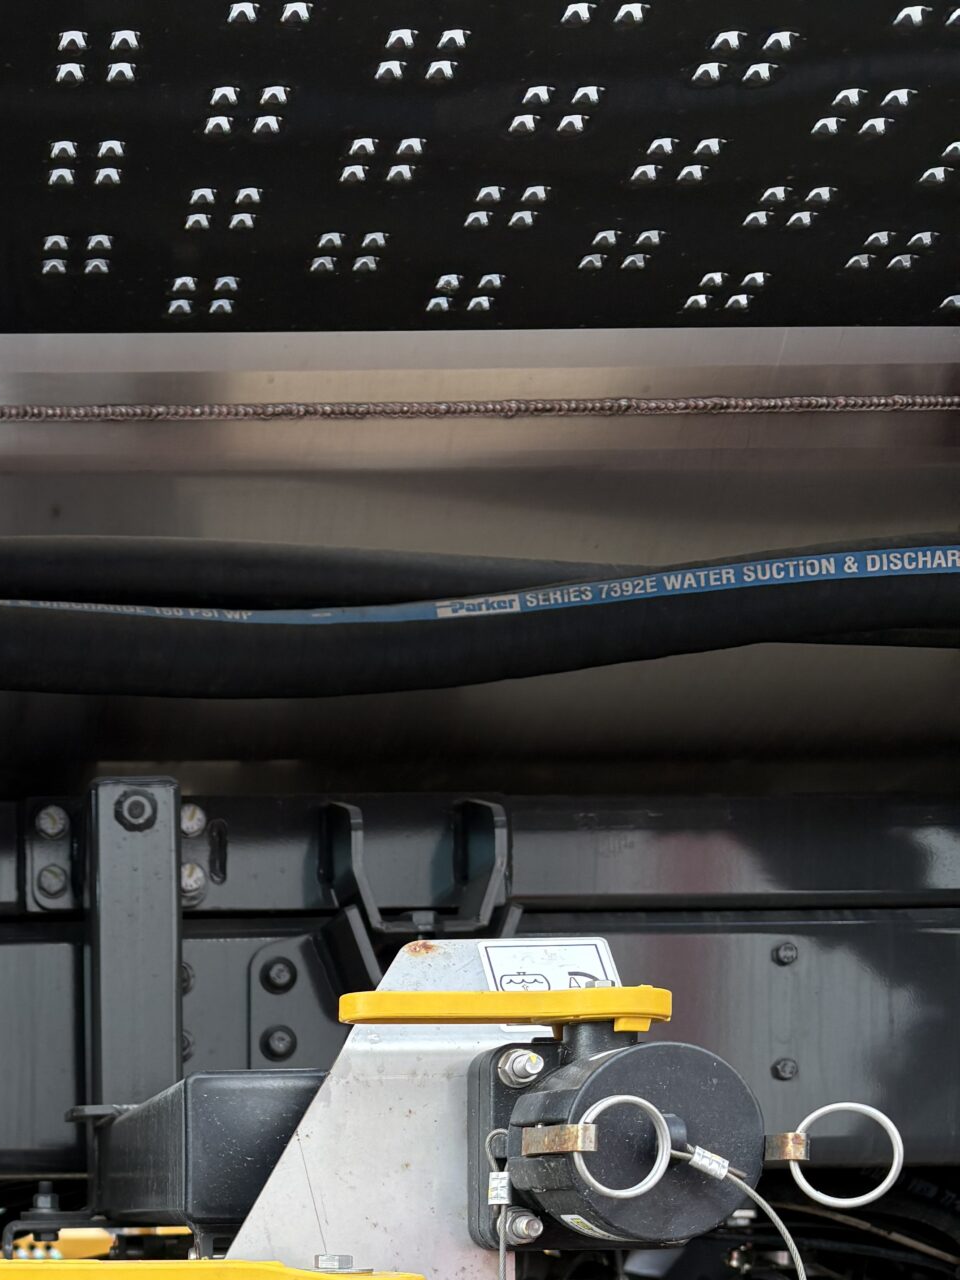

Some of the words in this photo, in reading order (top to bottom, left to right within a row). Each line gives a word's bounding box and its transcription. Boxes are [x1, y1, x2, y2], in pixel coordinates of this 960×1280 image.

[437, 595, 517, 614] Parker
[525, 586, 593, 607] SERIES
[598, 577, 658, 599] 7392E
[663, 568, 735, 591] WATER
[743, 557, 836, 583] SUCTION
[843, 556, 859, 574] &
[866, 550, 960, 572] DISCHAR
